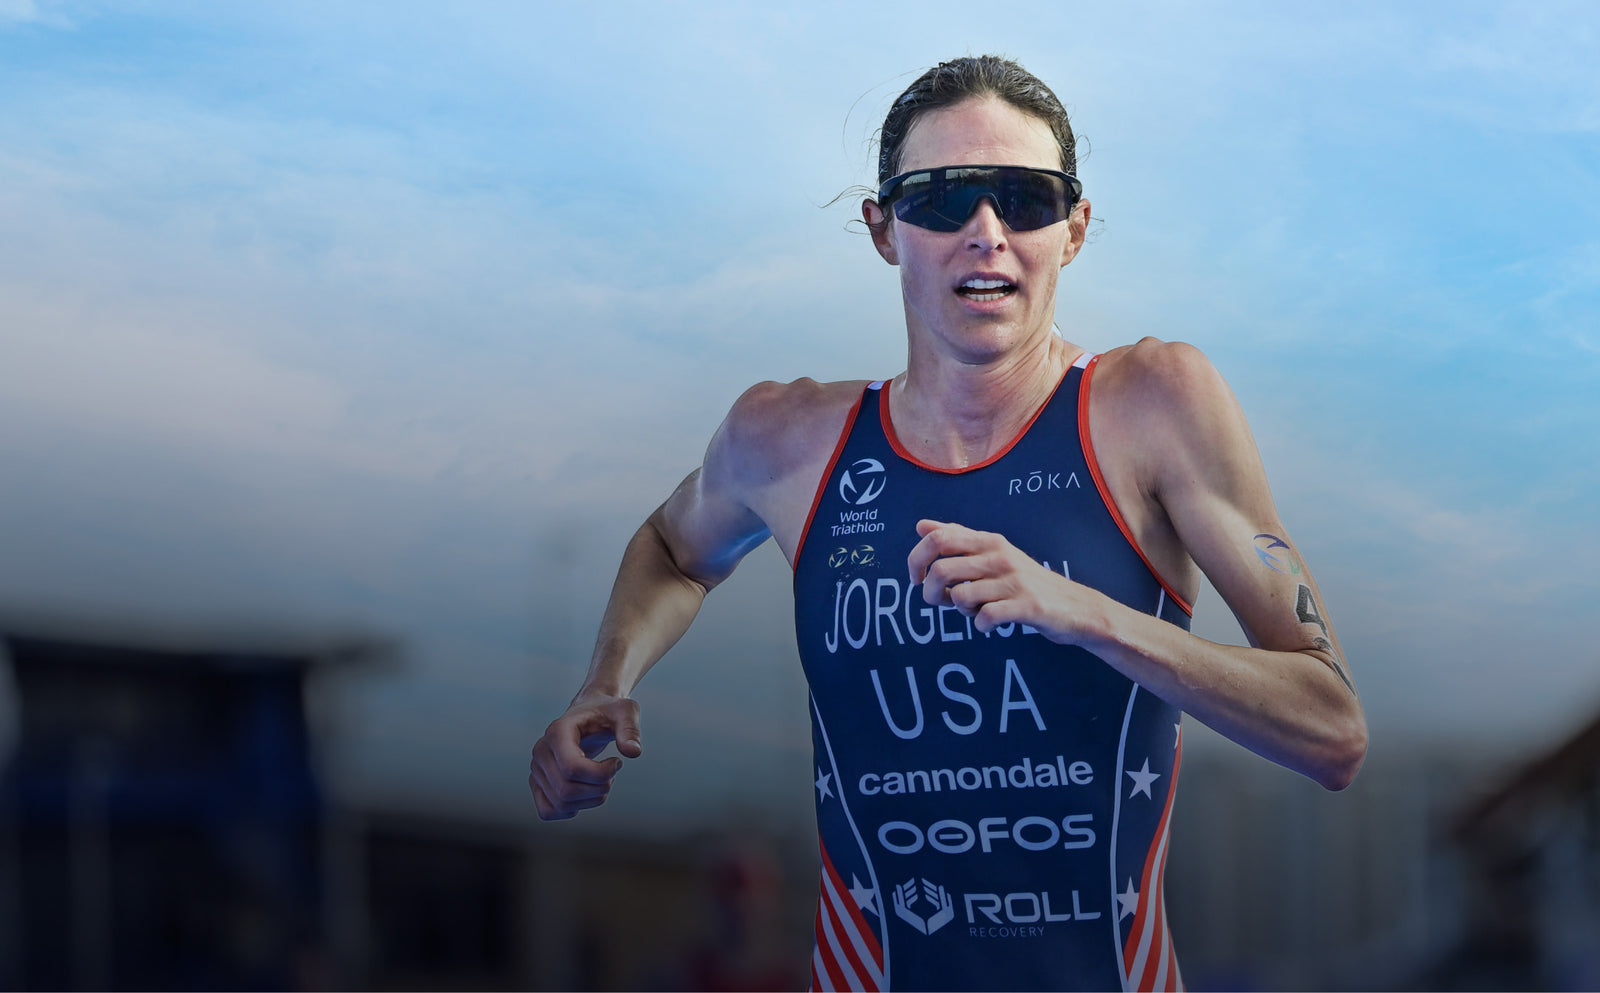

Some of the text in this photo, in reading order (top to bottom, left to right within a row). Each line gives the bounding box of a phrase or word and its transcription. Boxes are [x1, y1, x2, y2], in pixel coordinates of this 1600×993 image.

[839, 508, 878, 522] World
[831, 521, 885, 537] Triathlon
[870, 658, 1047, 739] USA
[858, 755, 1094, 796] cannondale
[964, 890, 1101, 924] ROLL
[969, 926, 1045, 938] RECOVERY
